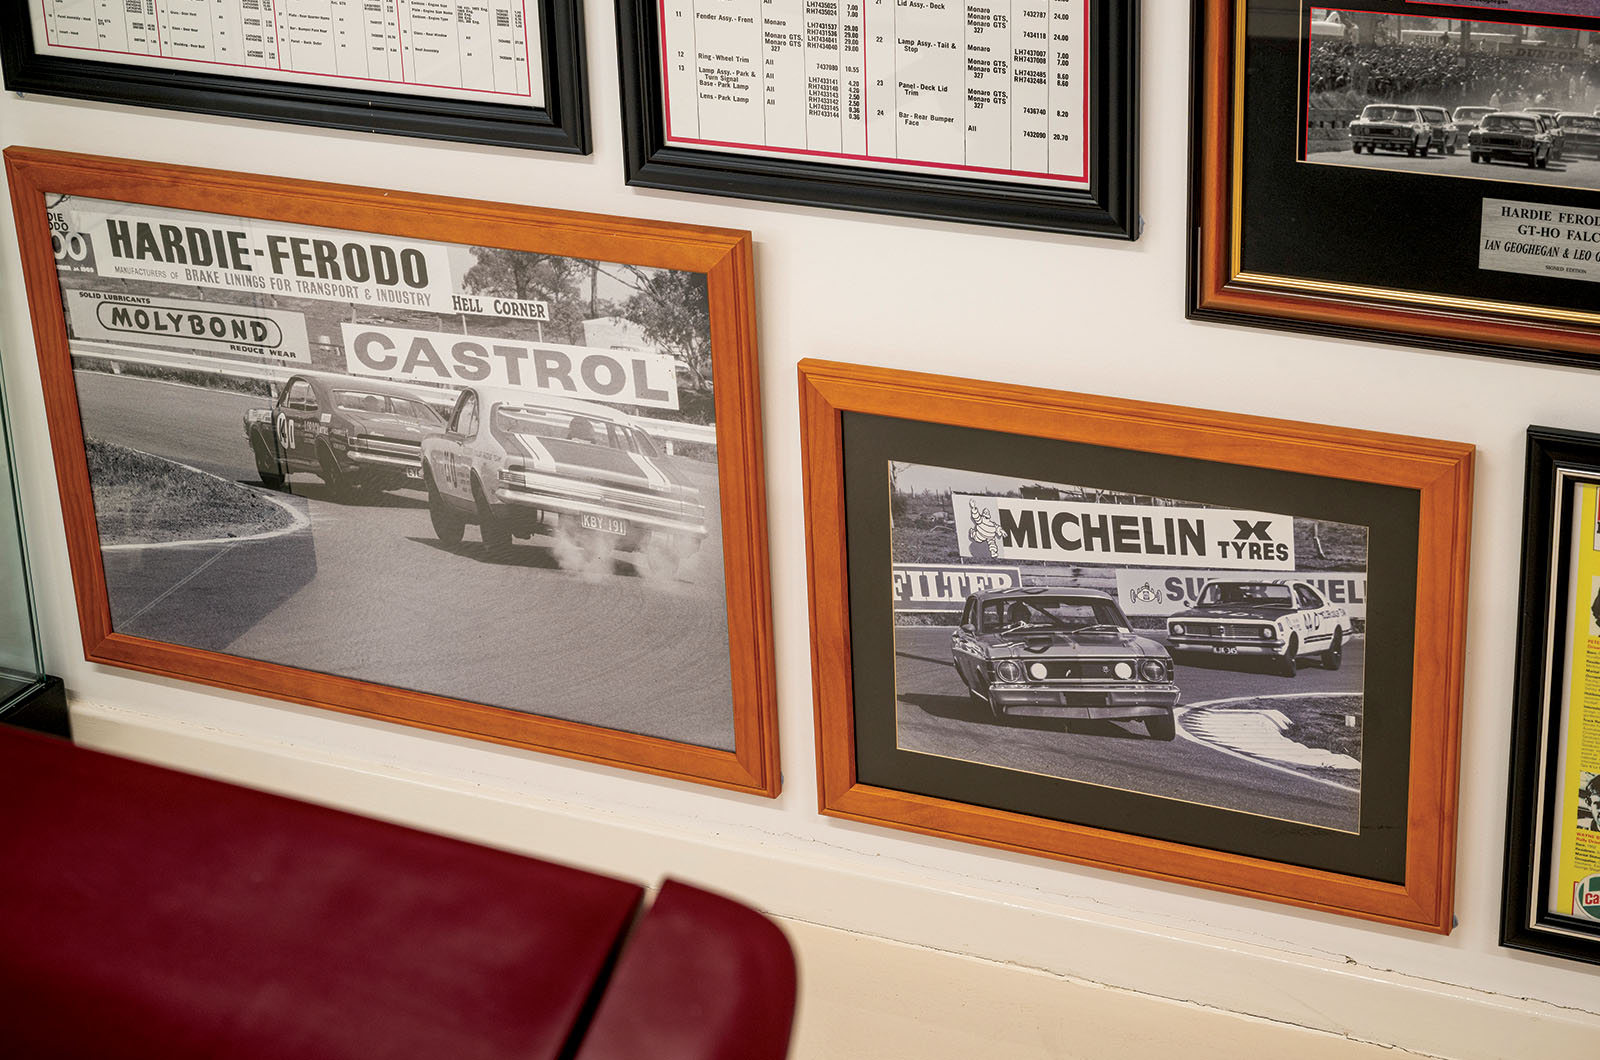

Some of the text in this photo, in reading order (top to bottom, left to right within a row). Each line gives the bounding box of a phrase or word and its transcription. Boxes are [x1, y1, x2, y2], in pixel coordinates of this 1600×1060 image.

[696, 13, 716, 21] Fender
[1023, 11, 1046, 19] 7432787
[898, 38, 915, 47] Lamp
[917, 40, 933, 48] Assy.
[698, 53, 711, 61] Ring
[699, 67, 714, 75] Lamp
[720, 75, 738, 84] Signal
[968, 95, 990, 104] Monaro
[930, 115, 954, 123] Bumper
[1502, 207, 1552, 221] HARDIE
[1518, 224, 1600, 243] GT-HO FALC
[106, 219, 429, 289] HARDIE-FERODO
[1485, 240, 1501, 250] IAN
[1504, 241, 1560, 257] GEOGHEGAN
[1562, 248, 1569, 258] &
[1573, 249, 1592, 260] LEO
[114, 266, 431, 306] MANUFACTURERS OF BRAKE LININGS FOR TRANSPORT & INDUSTRY
[79, 291, 151, 304] SOLID LUBRICANTS
[451, 295, 546, 318] HELL CORNER
[112, 307, 268, 341] MOLYBOND
[230, 345, 296, 358] REDUCE WEAR
[353, 332, 669, 402] CASTROL
[583, 514, 623, 533] KBY 191
[998, 508, 1206, 557] MICHELIN
[1218, 541, 1288, 562] TYRES
